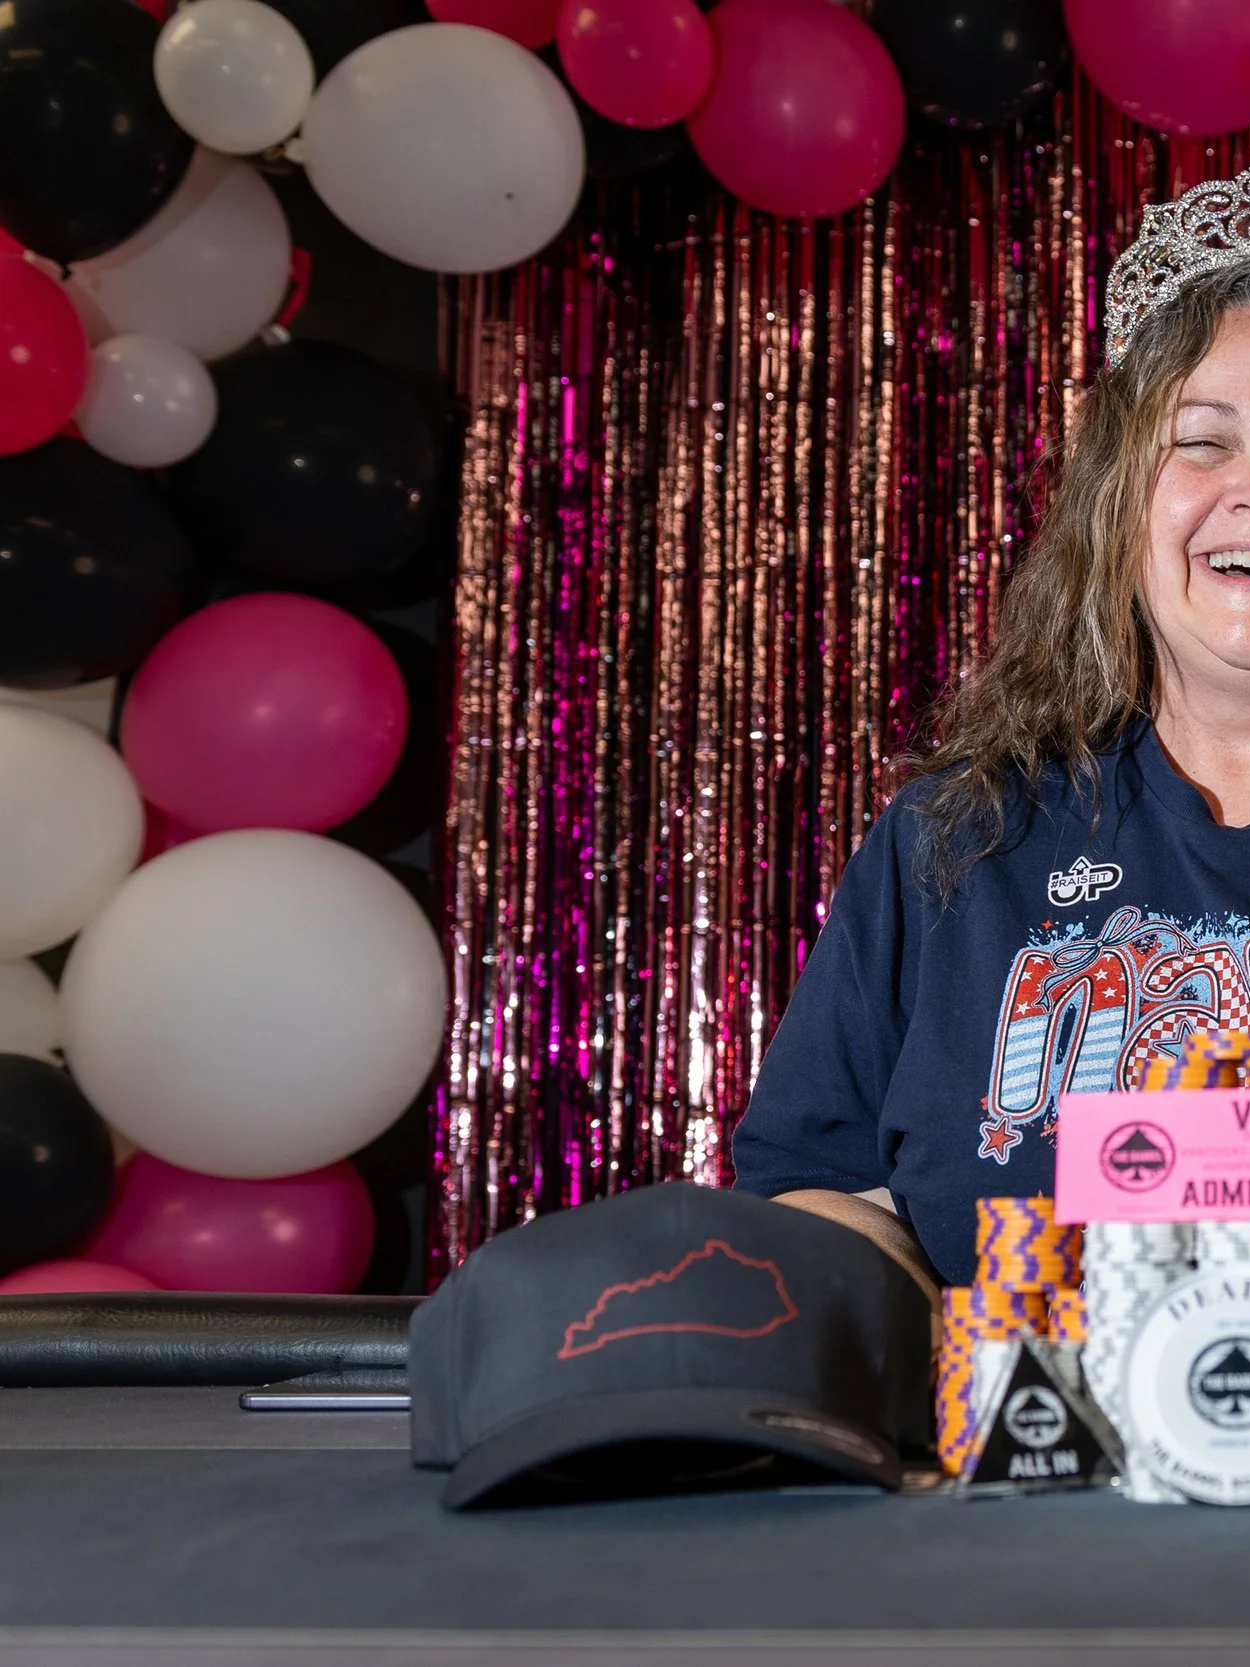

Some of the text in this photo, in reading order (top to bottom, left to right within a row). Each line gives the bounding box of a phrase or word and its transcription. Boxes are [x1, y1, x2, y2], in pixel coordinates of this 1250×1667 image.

[1050, 872, 1108, 889] #RAISEIT
[1051, 860, 1120, 903] UP
[1008, 1449, 1080, 1478] ALL IN
